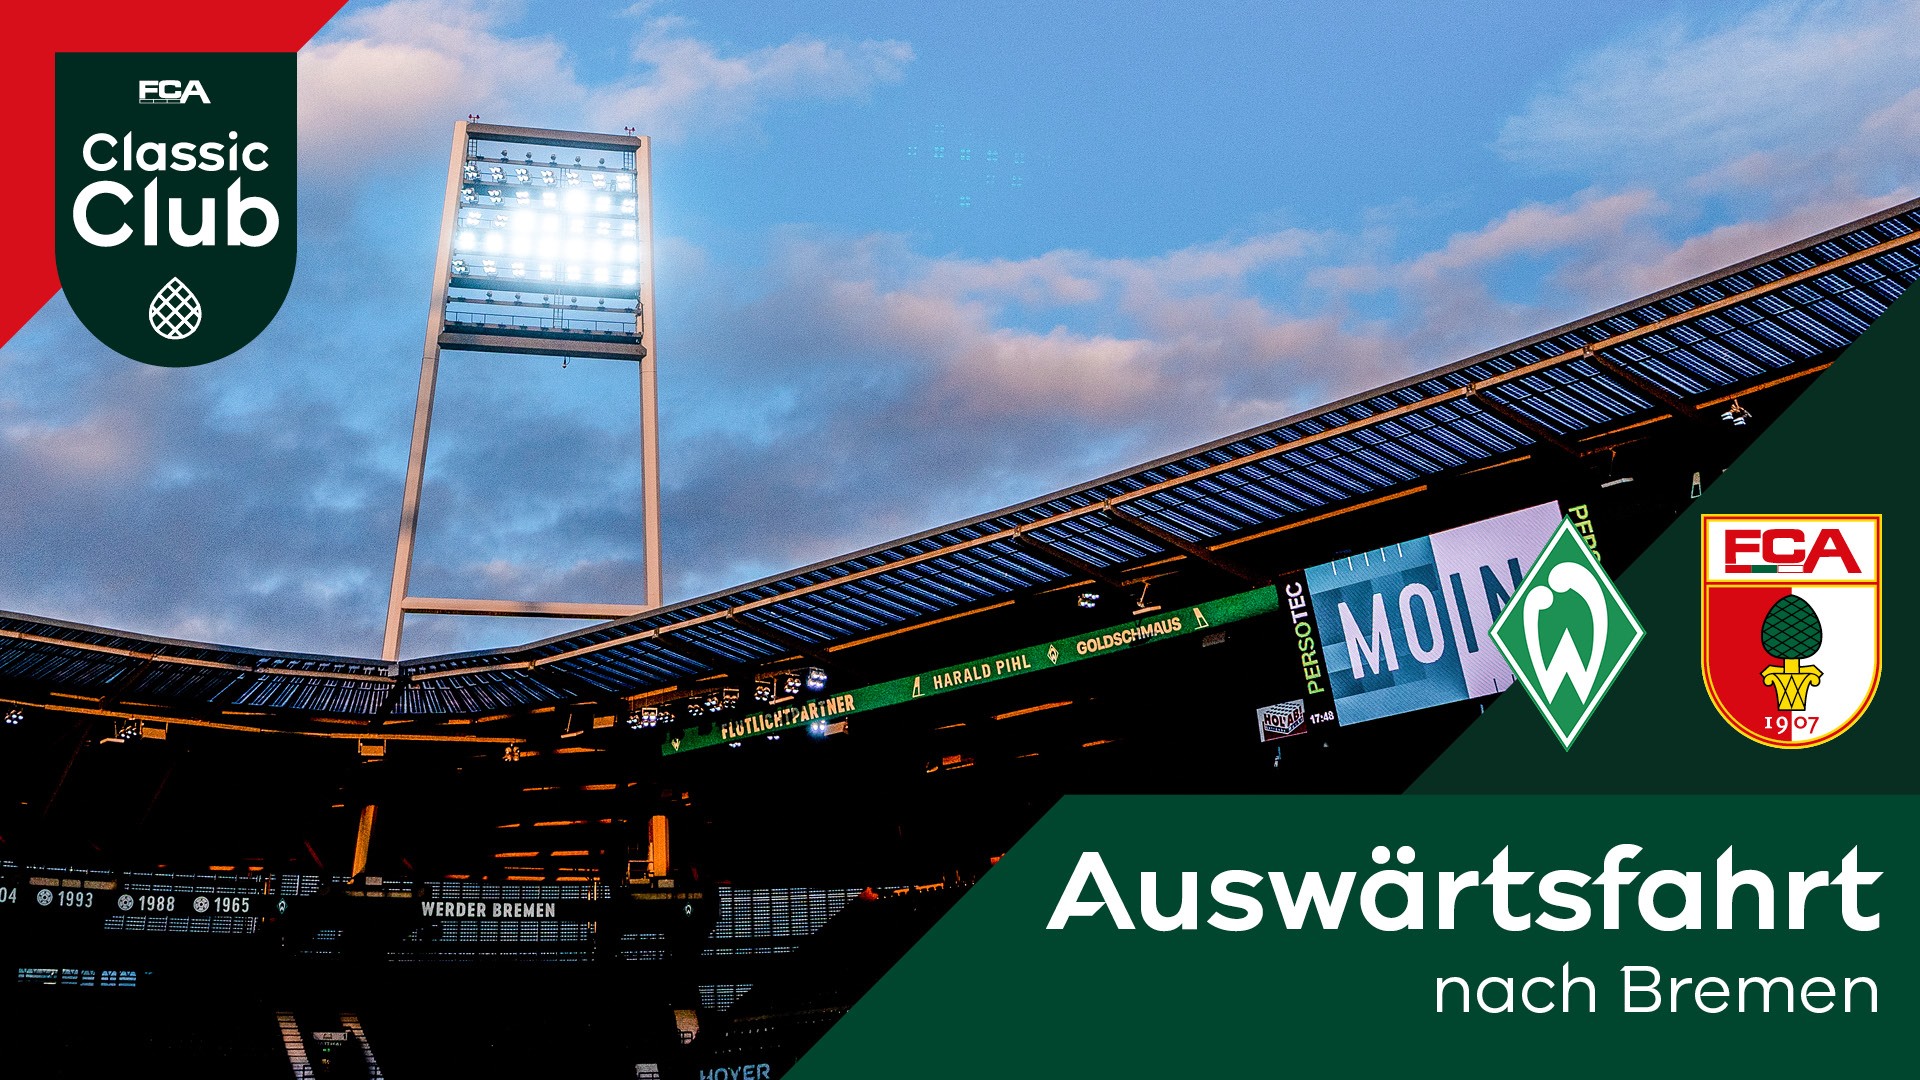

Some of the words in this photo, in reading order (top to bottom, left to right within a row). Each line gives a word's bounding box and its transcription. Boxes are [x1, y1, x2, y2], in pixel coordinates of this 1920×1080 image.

[1077, 617, 1182, 655] GOLDSCHMAUS
[1285, 581, 1325, 695] PERSOTEC
[933, 663, 992, 689] HARALD
[995, 655, 1031, 675] PIHL
[721, 694, 855, 740] FLUTLICHTPARTNER
[1310, 711, 1335, 724] 17:48
[58, 890, 94, 908] 1993
[138, 895, 176, 912] 1988
[214, 897, 250, 913] 1965
[421, 901, 487, 917] WERDER
[492, 902, 556, 918] BREMEN
